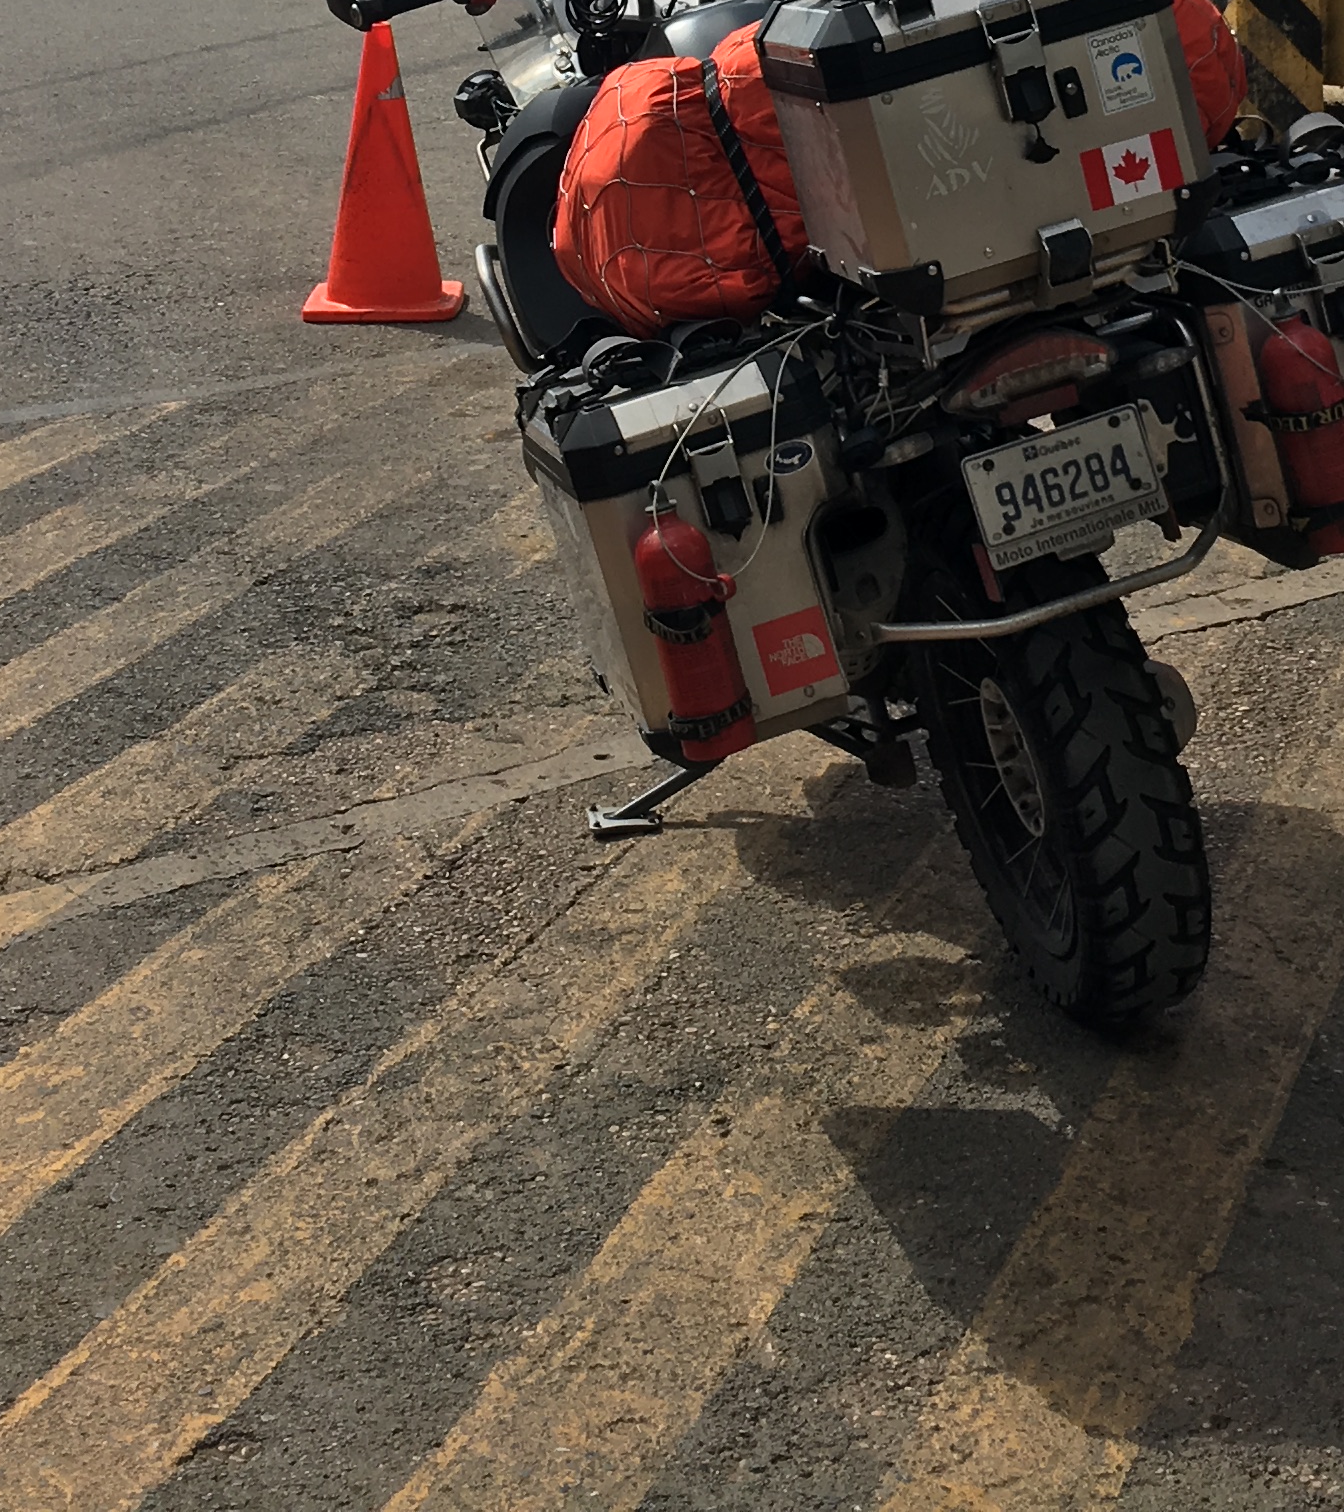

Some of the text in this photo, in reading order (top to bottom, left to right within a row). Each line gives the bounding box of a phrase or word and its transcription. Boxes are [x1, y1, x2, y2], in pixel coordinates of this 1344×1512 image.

[1091, 29, 1134, 48] Canada's
[926, 155, 993, 200] ADV
[1038, 437, 1081, 456] Québec
[994, 443, 1139, 523] 946284
[1031, 494, 1115, 529] Je me souviens
[995, 498, 1166, 567] Moto Internationale Mtl.
[782, 635, 803, 649] THE
[769, 645, 805, 662] NORTH
[782, 654, 808, 667] FACE
